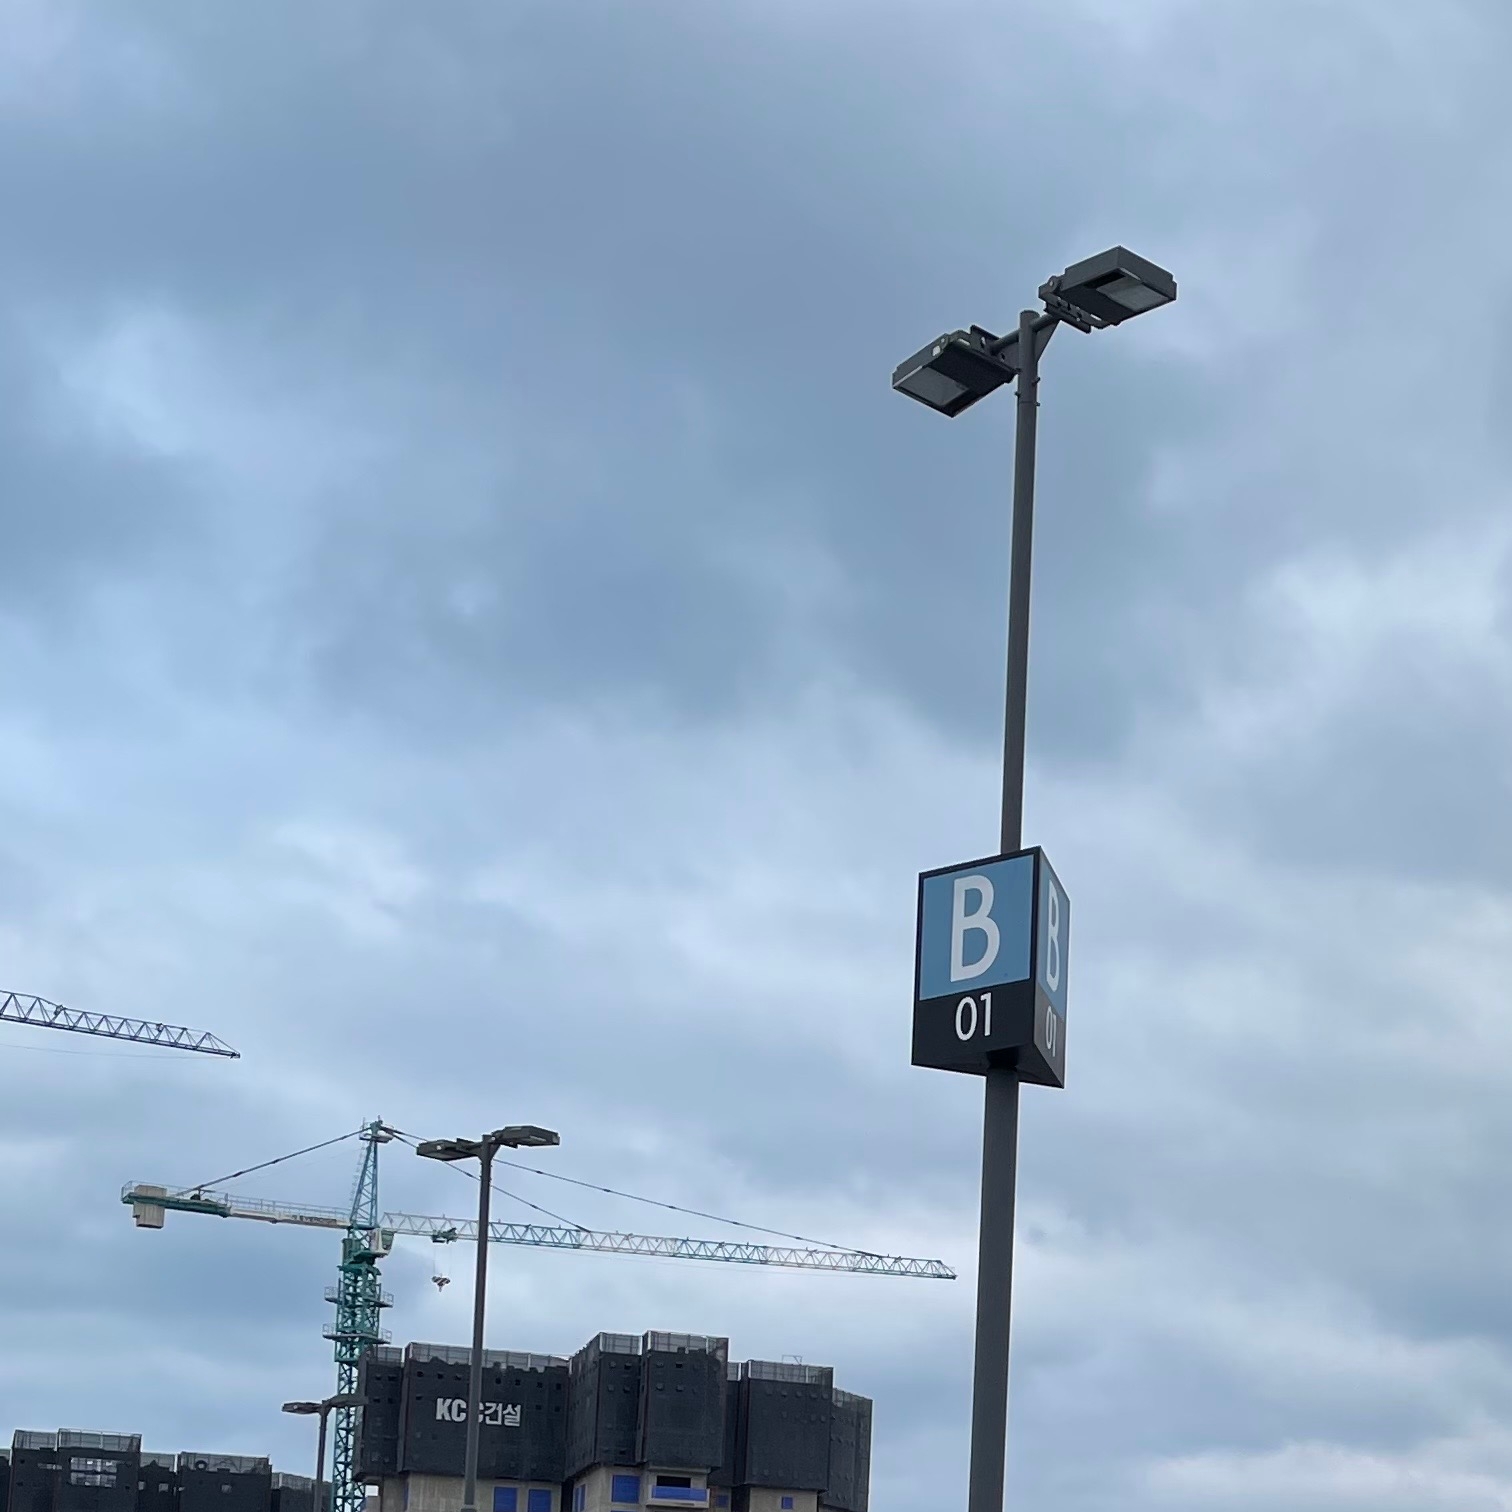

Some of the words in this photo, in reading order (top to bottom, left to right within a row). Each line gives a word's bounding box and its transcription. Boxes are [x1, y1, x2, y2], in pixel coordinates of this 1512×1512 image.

[950, 874, 1001, 983] B
[1046, 879, 1060, 993] B
[955, 992, 992, 1041] 01
[1045, 1005, 1057, 1058] 01
